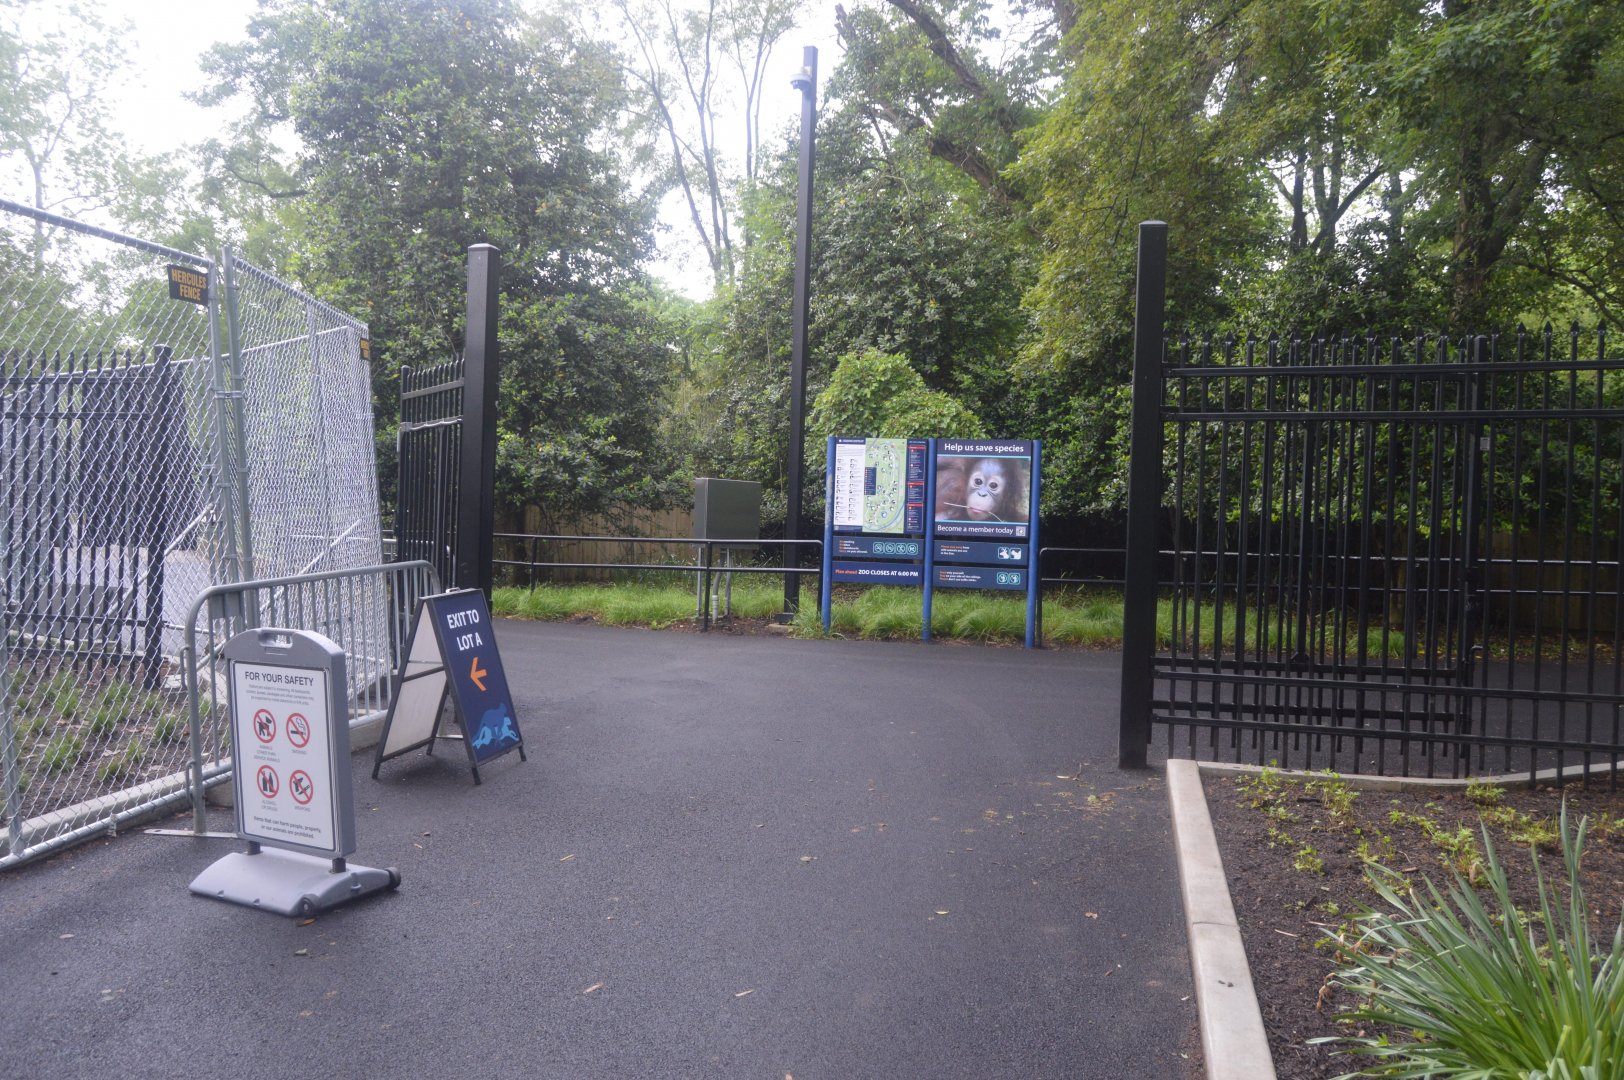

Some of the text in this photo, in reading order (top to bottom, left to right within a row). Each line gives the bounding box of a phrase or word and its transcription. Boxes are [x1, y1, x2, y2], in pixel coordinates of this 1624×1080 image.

[171, 268, 207, 289] HERCULES
[180, 284, 201, 300] FENCE
[944, 443, 963, 452] Help
[994, 444, 1024, 453] species
[937, 524, 962, 532] Become
[995, 527, 1013, 535] today
[446, 609, 480, 629] EXIT TO
[456, 632, 483, 651] LOT A
[245, 671, 314, 686] FOR YOUR SAFETY
